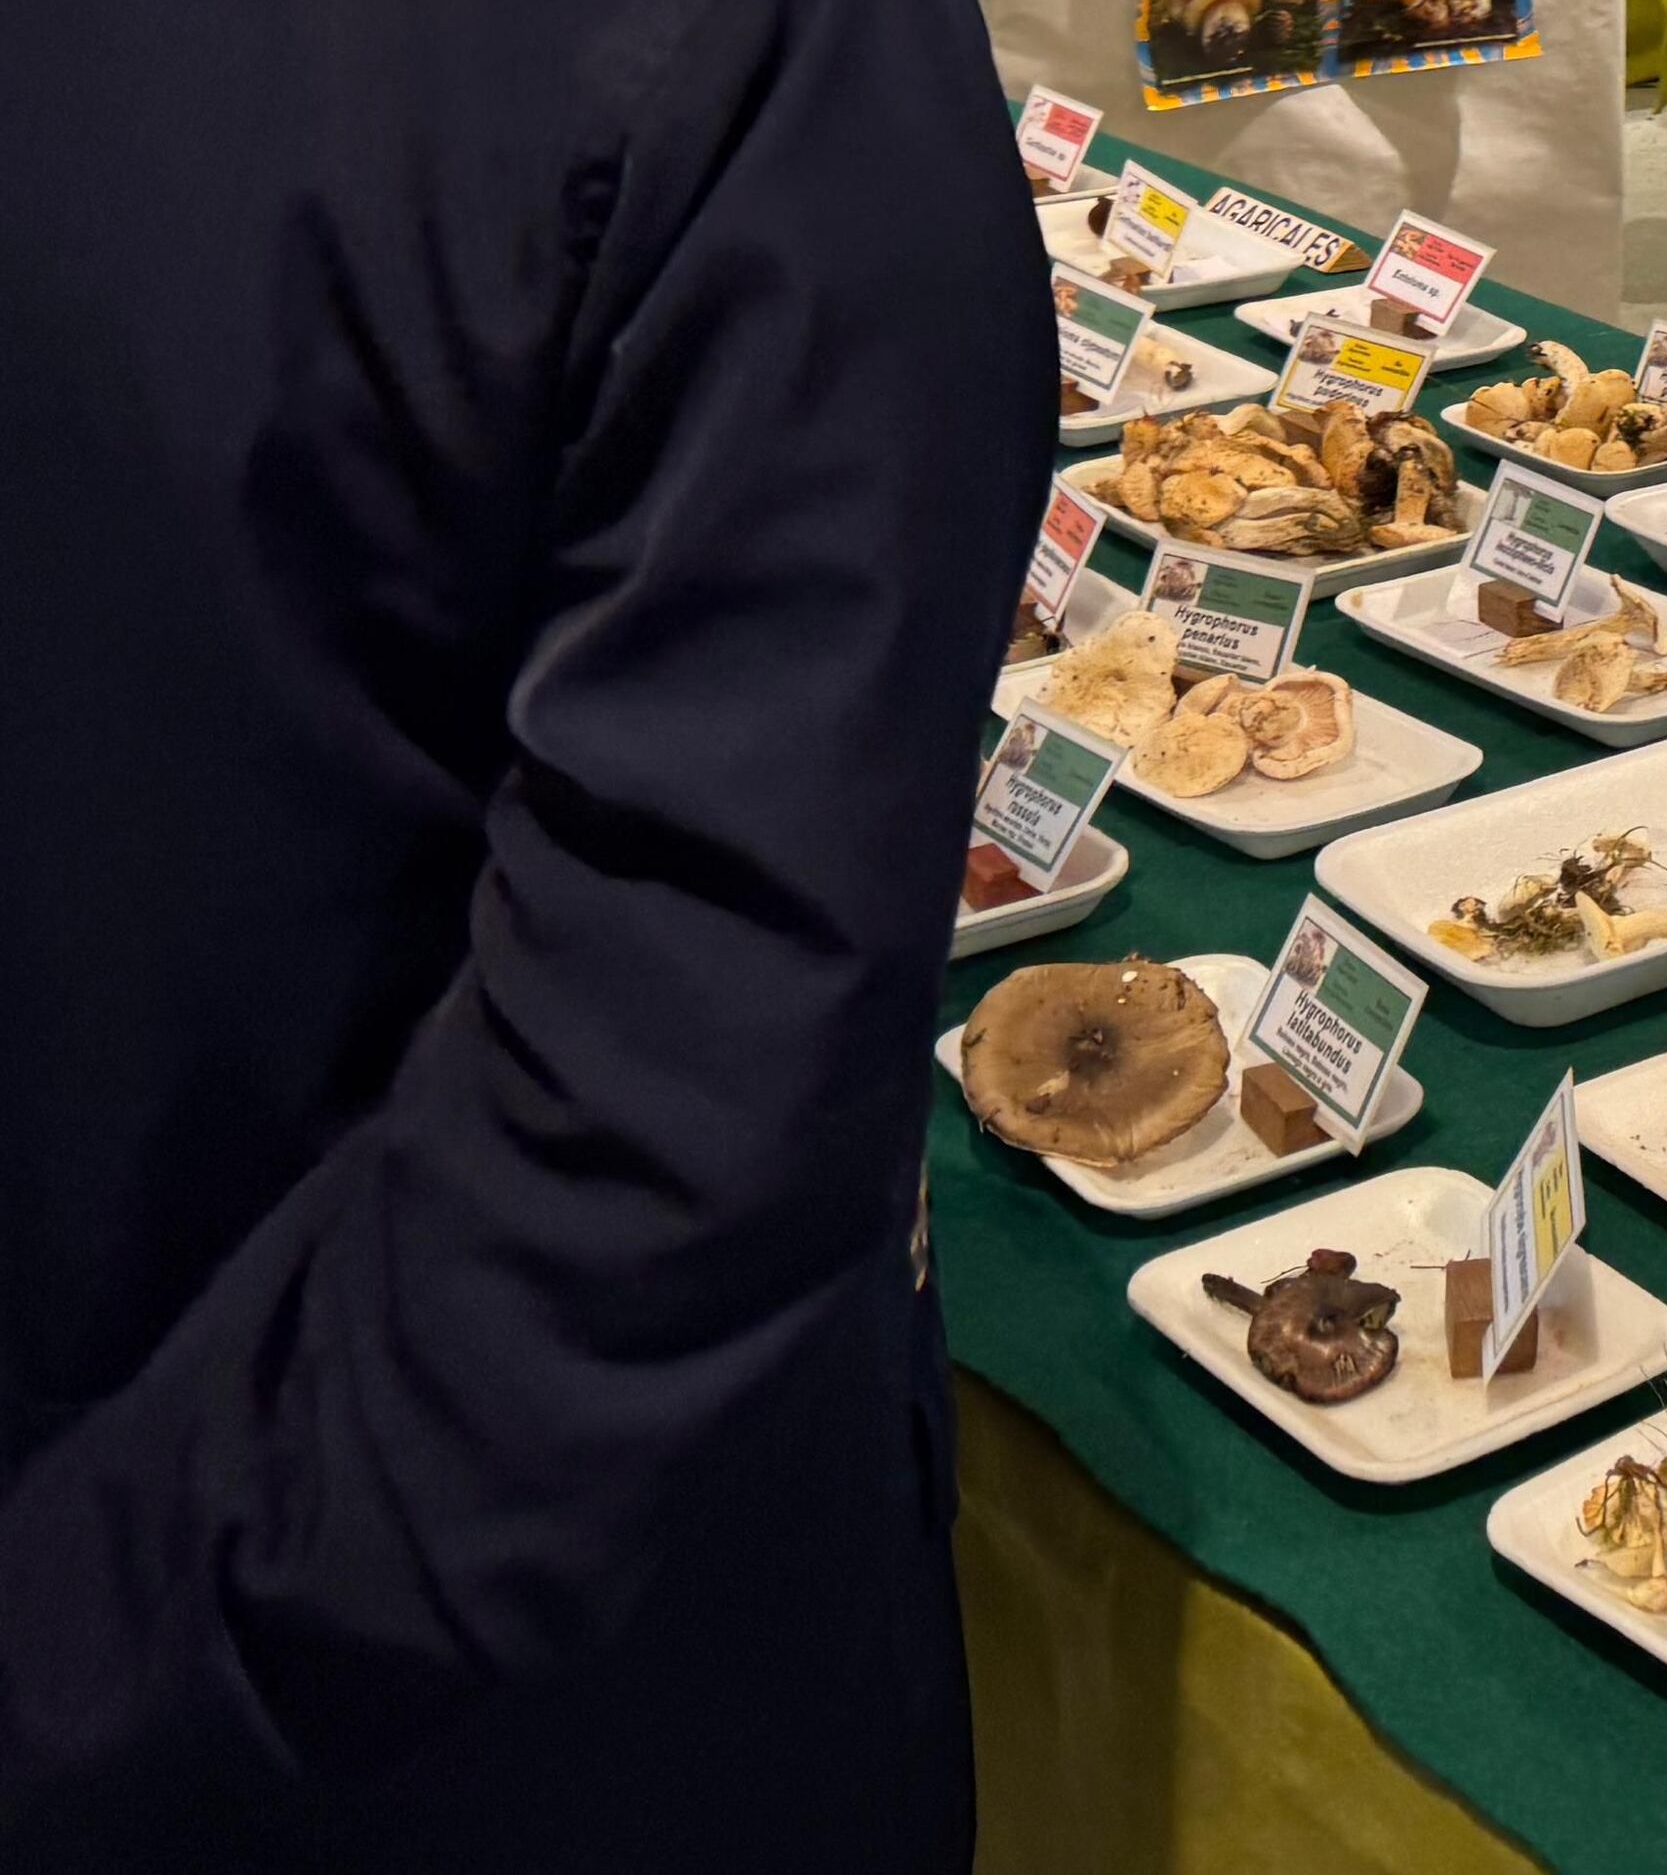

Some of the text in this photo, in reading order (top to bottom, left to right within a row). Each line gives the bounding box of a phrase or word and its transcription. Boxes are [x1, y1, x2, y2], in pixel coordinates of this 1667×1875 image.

[1210, 194, 1341, 268] AGARICALES
[1174, 603, 1259, 636] Hygrophorus
[1181, 627, 1240, 649] penarius
[1285, 1008, 1352, 1076] latitabundus
[1293, 987, 1363, 1056] Hygrophorus
